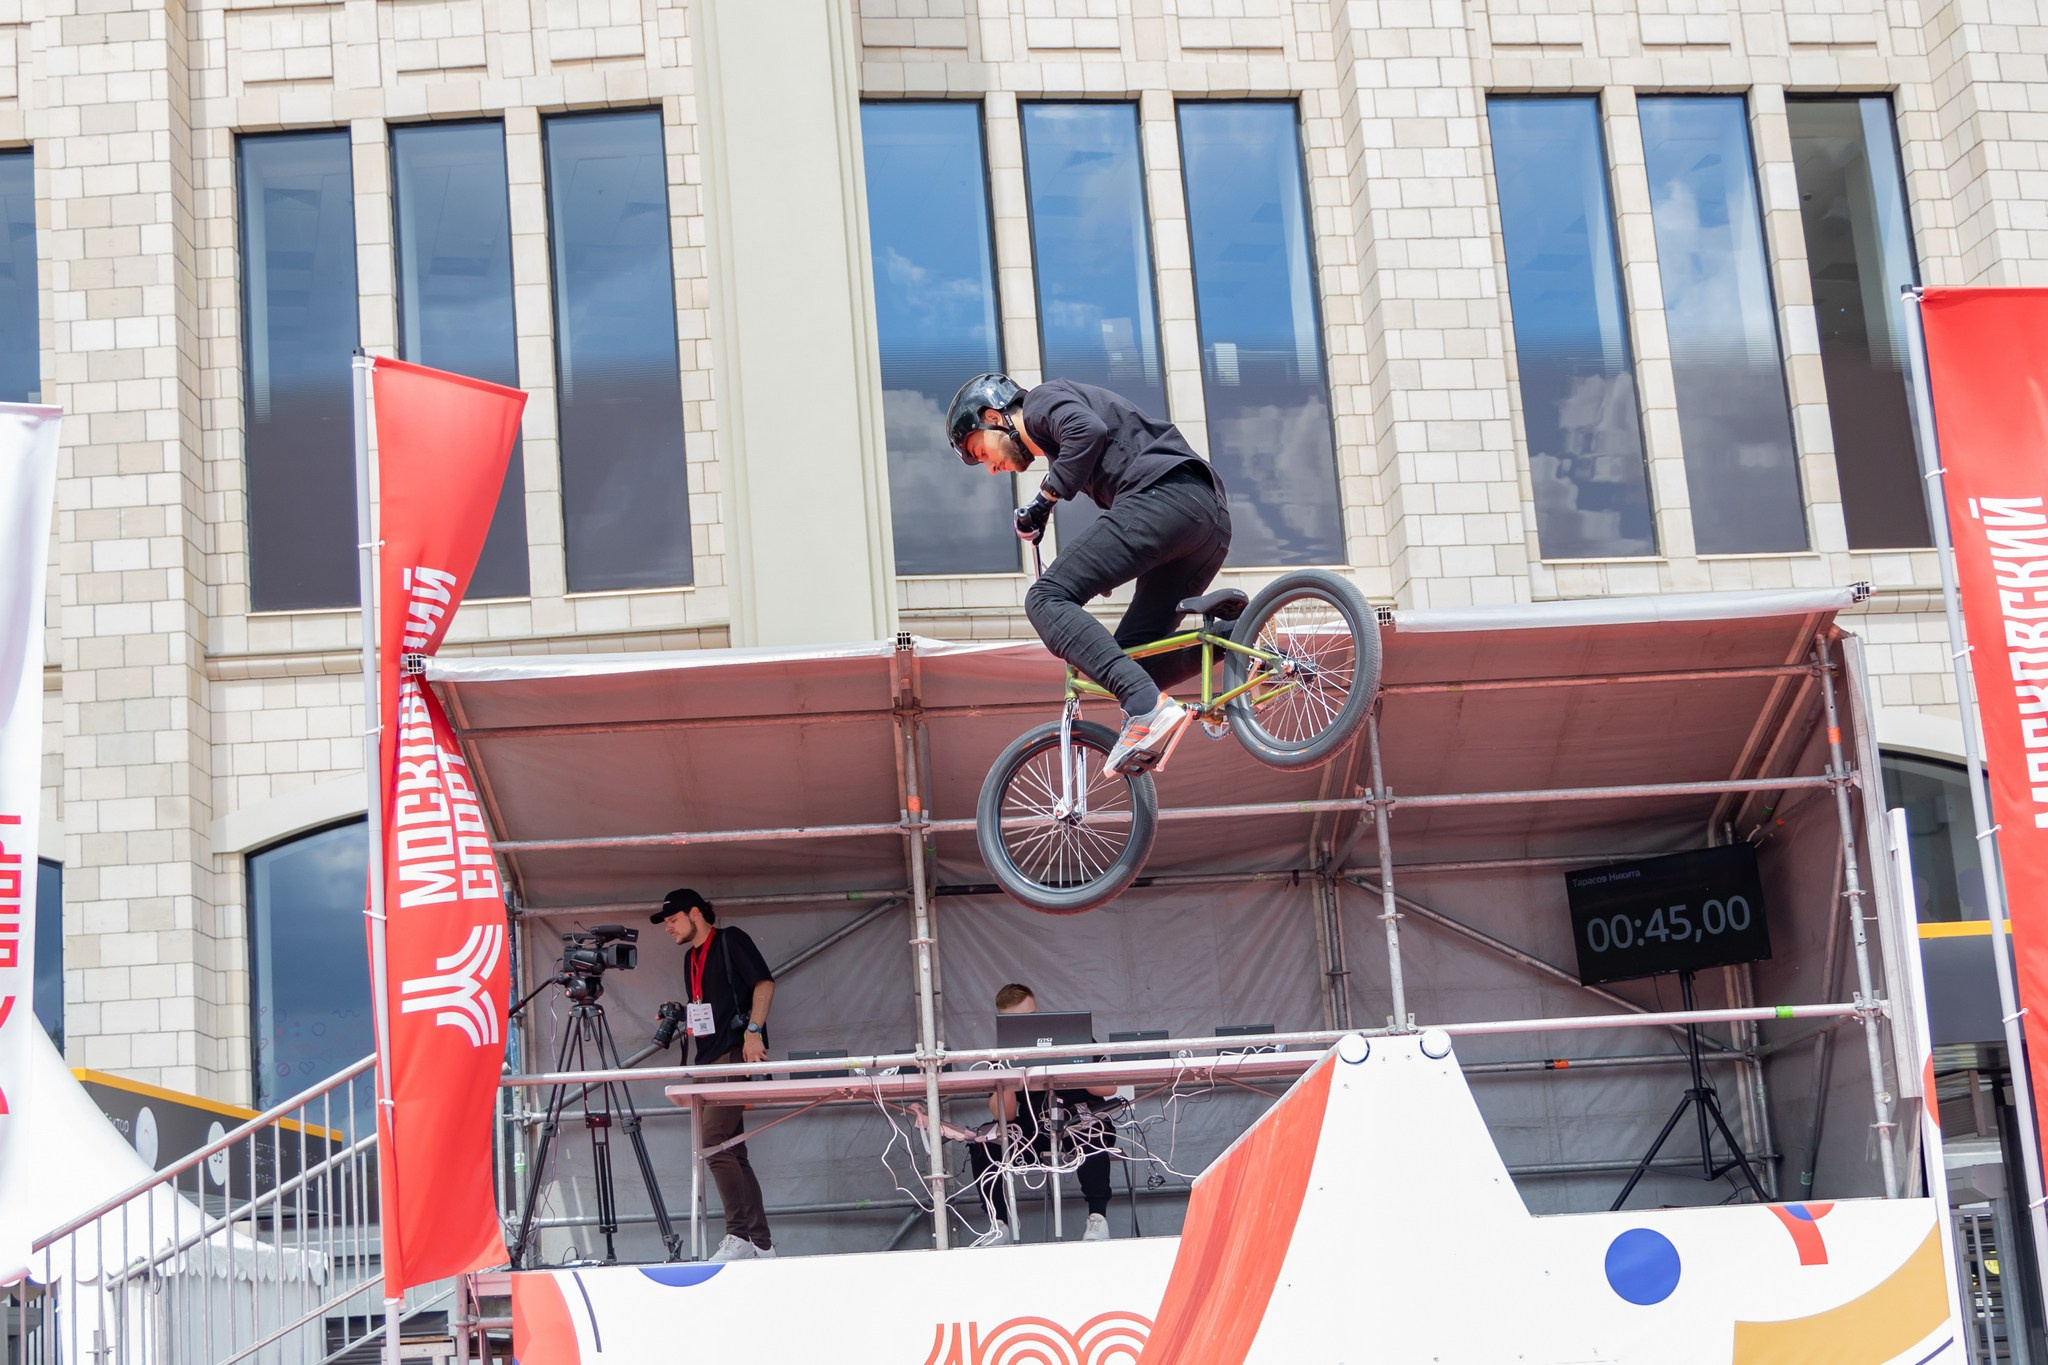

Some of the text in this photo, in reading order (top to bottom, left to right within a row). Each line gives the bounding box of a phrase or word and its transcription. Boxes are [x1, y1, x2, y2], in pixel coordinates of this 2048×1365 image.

[436, 744, 499, 899] СПОРТ
[1572, 869, 1641, 888] Тарасов Никита
[1587, 895, 1750, 953] 00:45,00
